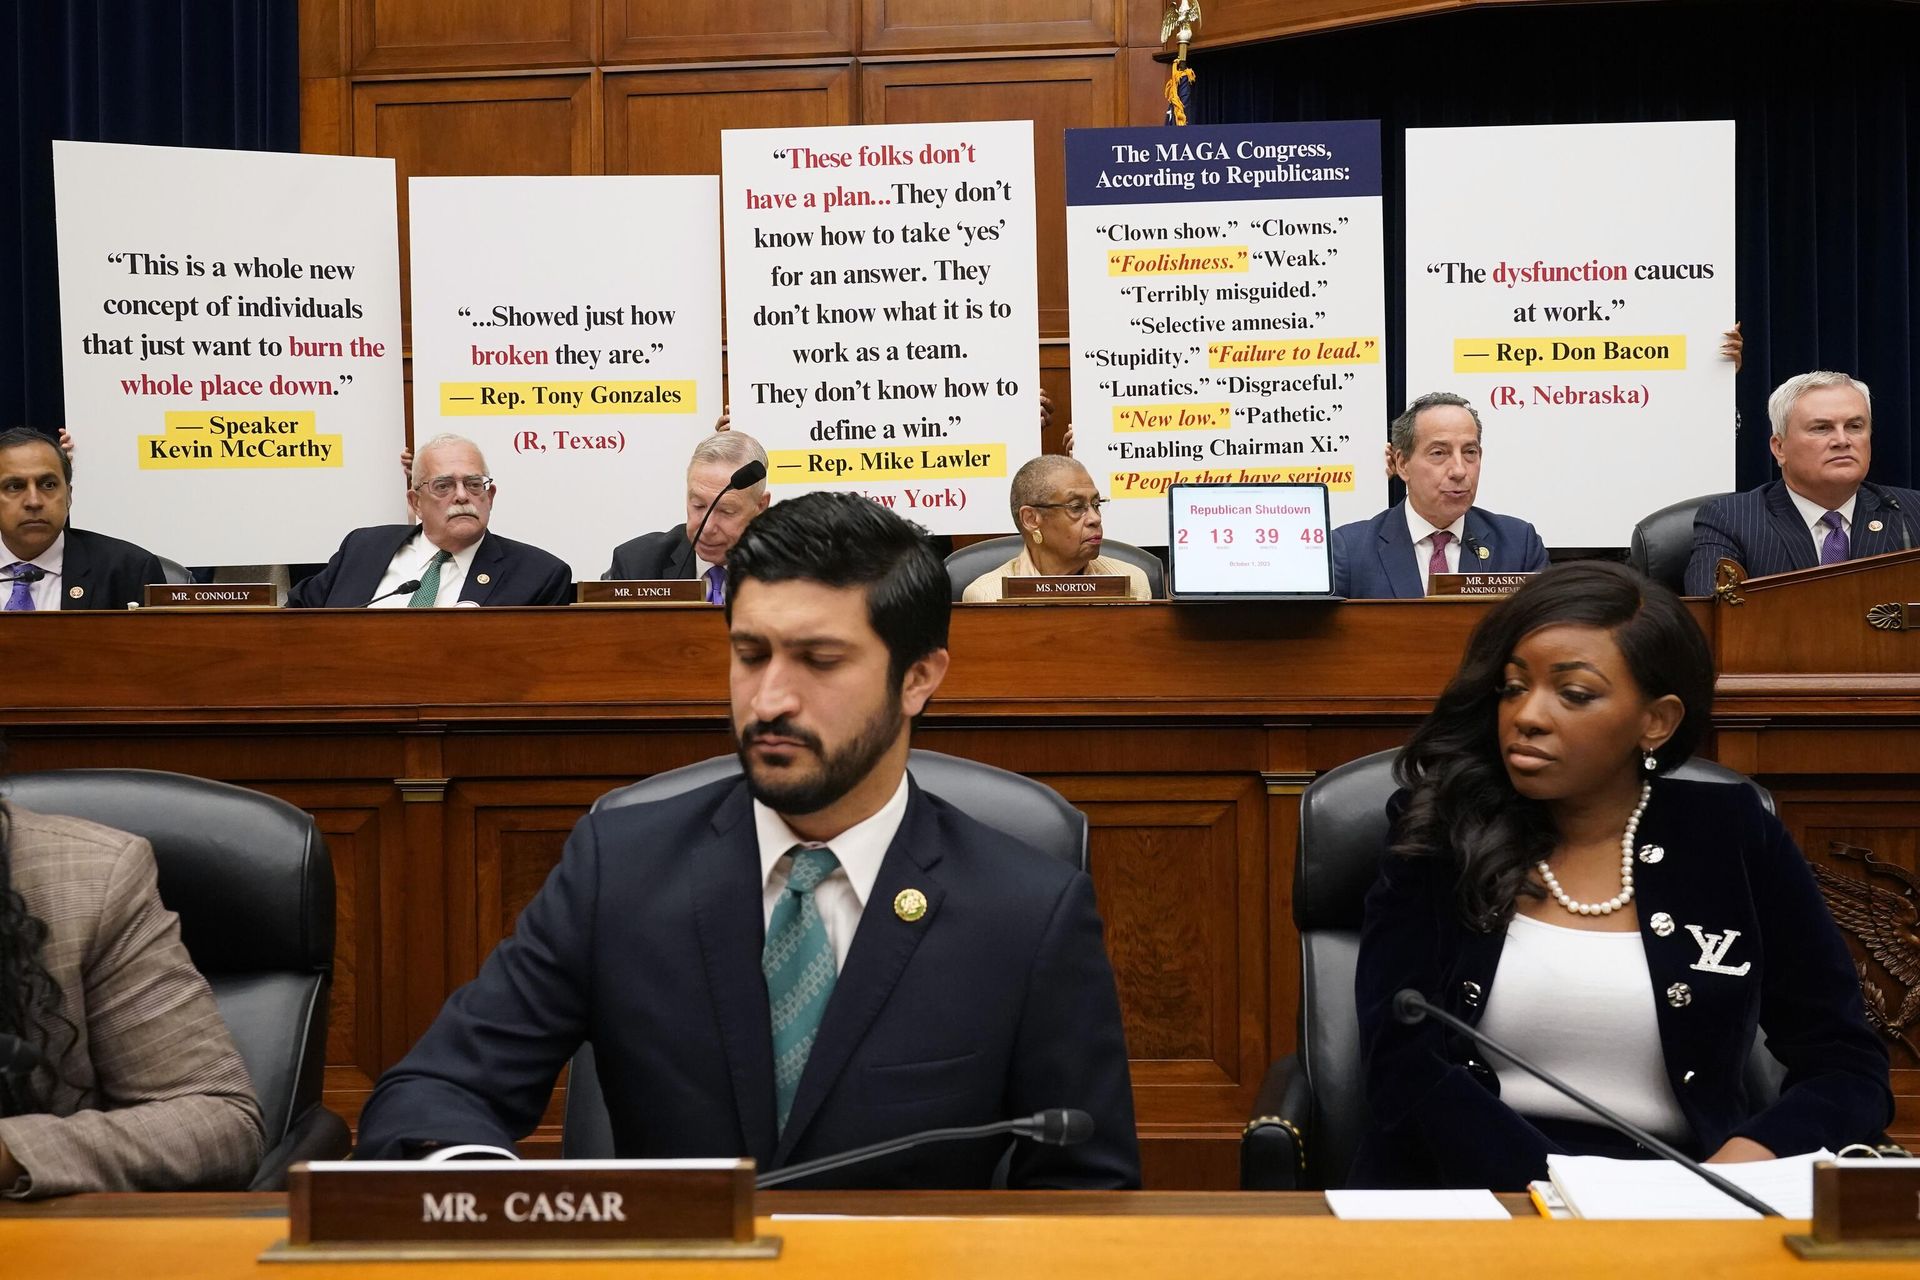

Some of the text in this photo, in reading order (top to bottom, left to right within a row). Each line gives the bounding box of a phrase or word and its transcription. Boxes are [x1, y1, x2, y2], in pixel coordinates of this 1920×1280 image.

[774, 143, 975, 168] “These folks don’t
[1112, 141, 1331, 163] The MAGA Congress,
[1096, 164, 1349, 190] According to Republicans:
[747, 189, 796, 209] have
[804, 193, 816, 207] a
[955, 180, 1011, 202] don’t
[755, 219, 1005, 248] know how to take ‘yes’
[1097, 217, 1348, 241] “Clown show.” “Clowns.”
[108, 253, 354, 279] “This is a whole new
[1111, 249, 1337, 272] “Foolishness.” “Weak.”
[771, 260, 990, 286] for an answer. They
[1427, 260, 1714, 288] “The dysfunction caucus
[1121, 280, 1327, 305] “Terribly misguided.”
[104, 296, 362, 321] concept of individuals
[458, 305, 675, 331] “...Showed just how
[754, 298, 1011, 326] don’t know what it is to
[1514, 299, 1624, 322] at work.”
[1131, 312, 1325, 334] “Selective amnesia.”
[82, 333, 384, 361] that just want to burn the
[472, 343, 663, 369] broken they are.”
[793, 342, 967, 363] work as a team.
[1085, 341, 1374, 370] “Stupidity.” “Failure to lead.”
[1498, 344, 1543, 366] Rep.
[1553, 343, 1595, 360] Don
[1604, 342, 1668, 359] Bacon
[121, 374, 352, 401] whole place down.”
[751, 378, 1018, 408] They don’t know how to
[1100, 373, 1354, 397] “Lunatics.” “Disgraceful.”
[1491, 385, 1649, 409] (R, Nebraska)
[482, 387, 525, 409] Rep.
[532, 387, 583, 408] Tony
[591, 386, 681, 403] Gonzales
[210, 416, 298, 438] Speaker
[1121, 404, 1342, 427] “New low.” “Pathetic.”
[810, 416, 961, 441] define a win.”
[150, 439, 331, 461] Kevin McCarthy
[514, 431, 625, 454] (R, Texas)
[1108, 435, 1349, 461] “Enabling Chairman Xi.”
[809, 455, 852, 476] Rep.
[861, 452, 913, 469] Mike
[922, 450, 990, 468] Lawler
[1196, 470, 1232, 483] that
[1241, 469, 1281, 483] have
[1288, 466, 1352, 483] serious
[904, 489, 966, 511] York)
[1191, 505, 1310, 516] Republican Shutdown
[1178, 529, 1324, 543] 2 13 39 48
[195, 592, 249, 600] CONNOLLY
[615, 588, 670, 596] MR. LYNCH
[1036, 584, 1053, 592] MS.
[424, 1193, 624, 1221] MR. CASAR
